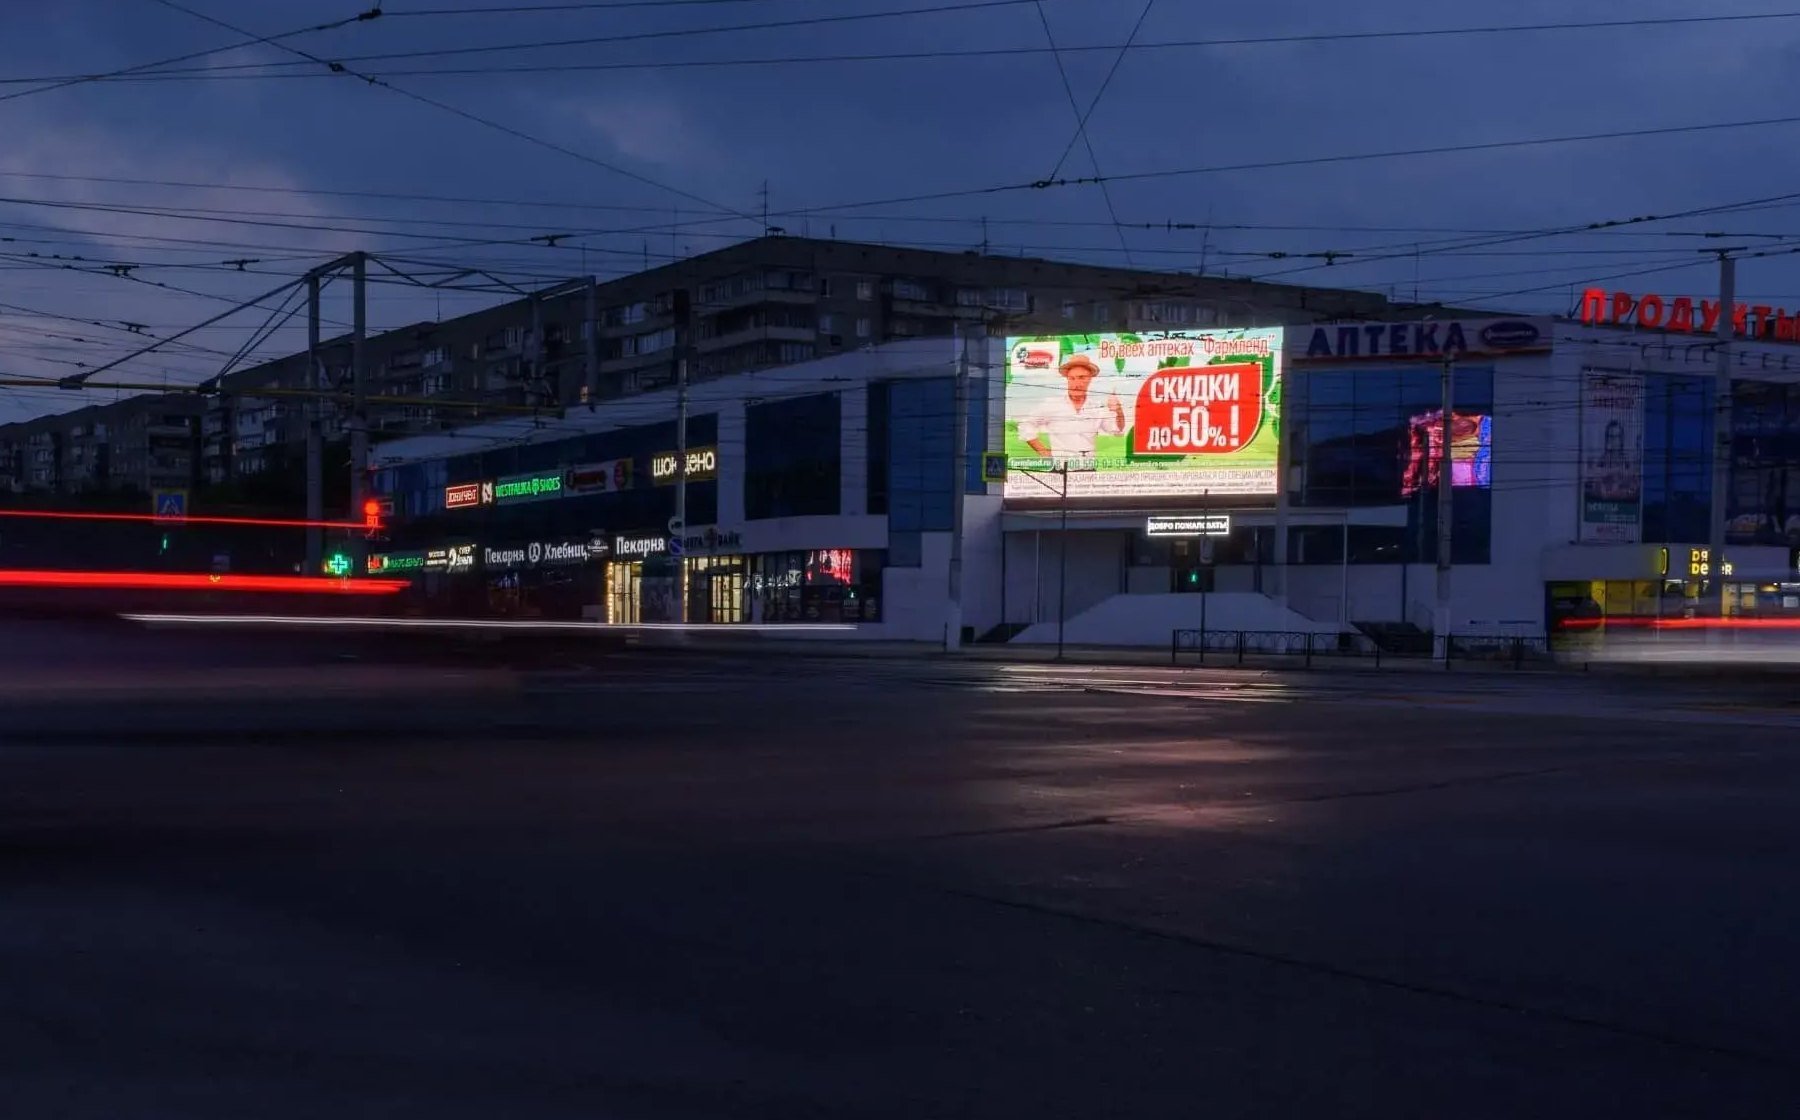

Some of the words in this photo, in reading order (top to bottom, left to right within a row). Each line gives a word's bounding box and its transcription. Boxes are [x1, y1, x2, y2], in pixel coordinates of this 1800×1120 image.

[1119, 343, 1145, 358] всех
[1147, 341, 1195, 357] аптеках
[1306, 322, 1467, 357] АПТЕКА
[1150, 373, 1239, 406] СКИДКИ
[1149, 522, 1174, 531] ДОБРО
[484, 547, 525, 567] Пекарня
[544, 541, 591, 562] Хлебниц
[615, 535, 665, 560] Пекарня
